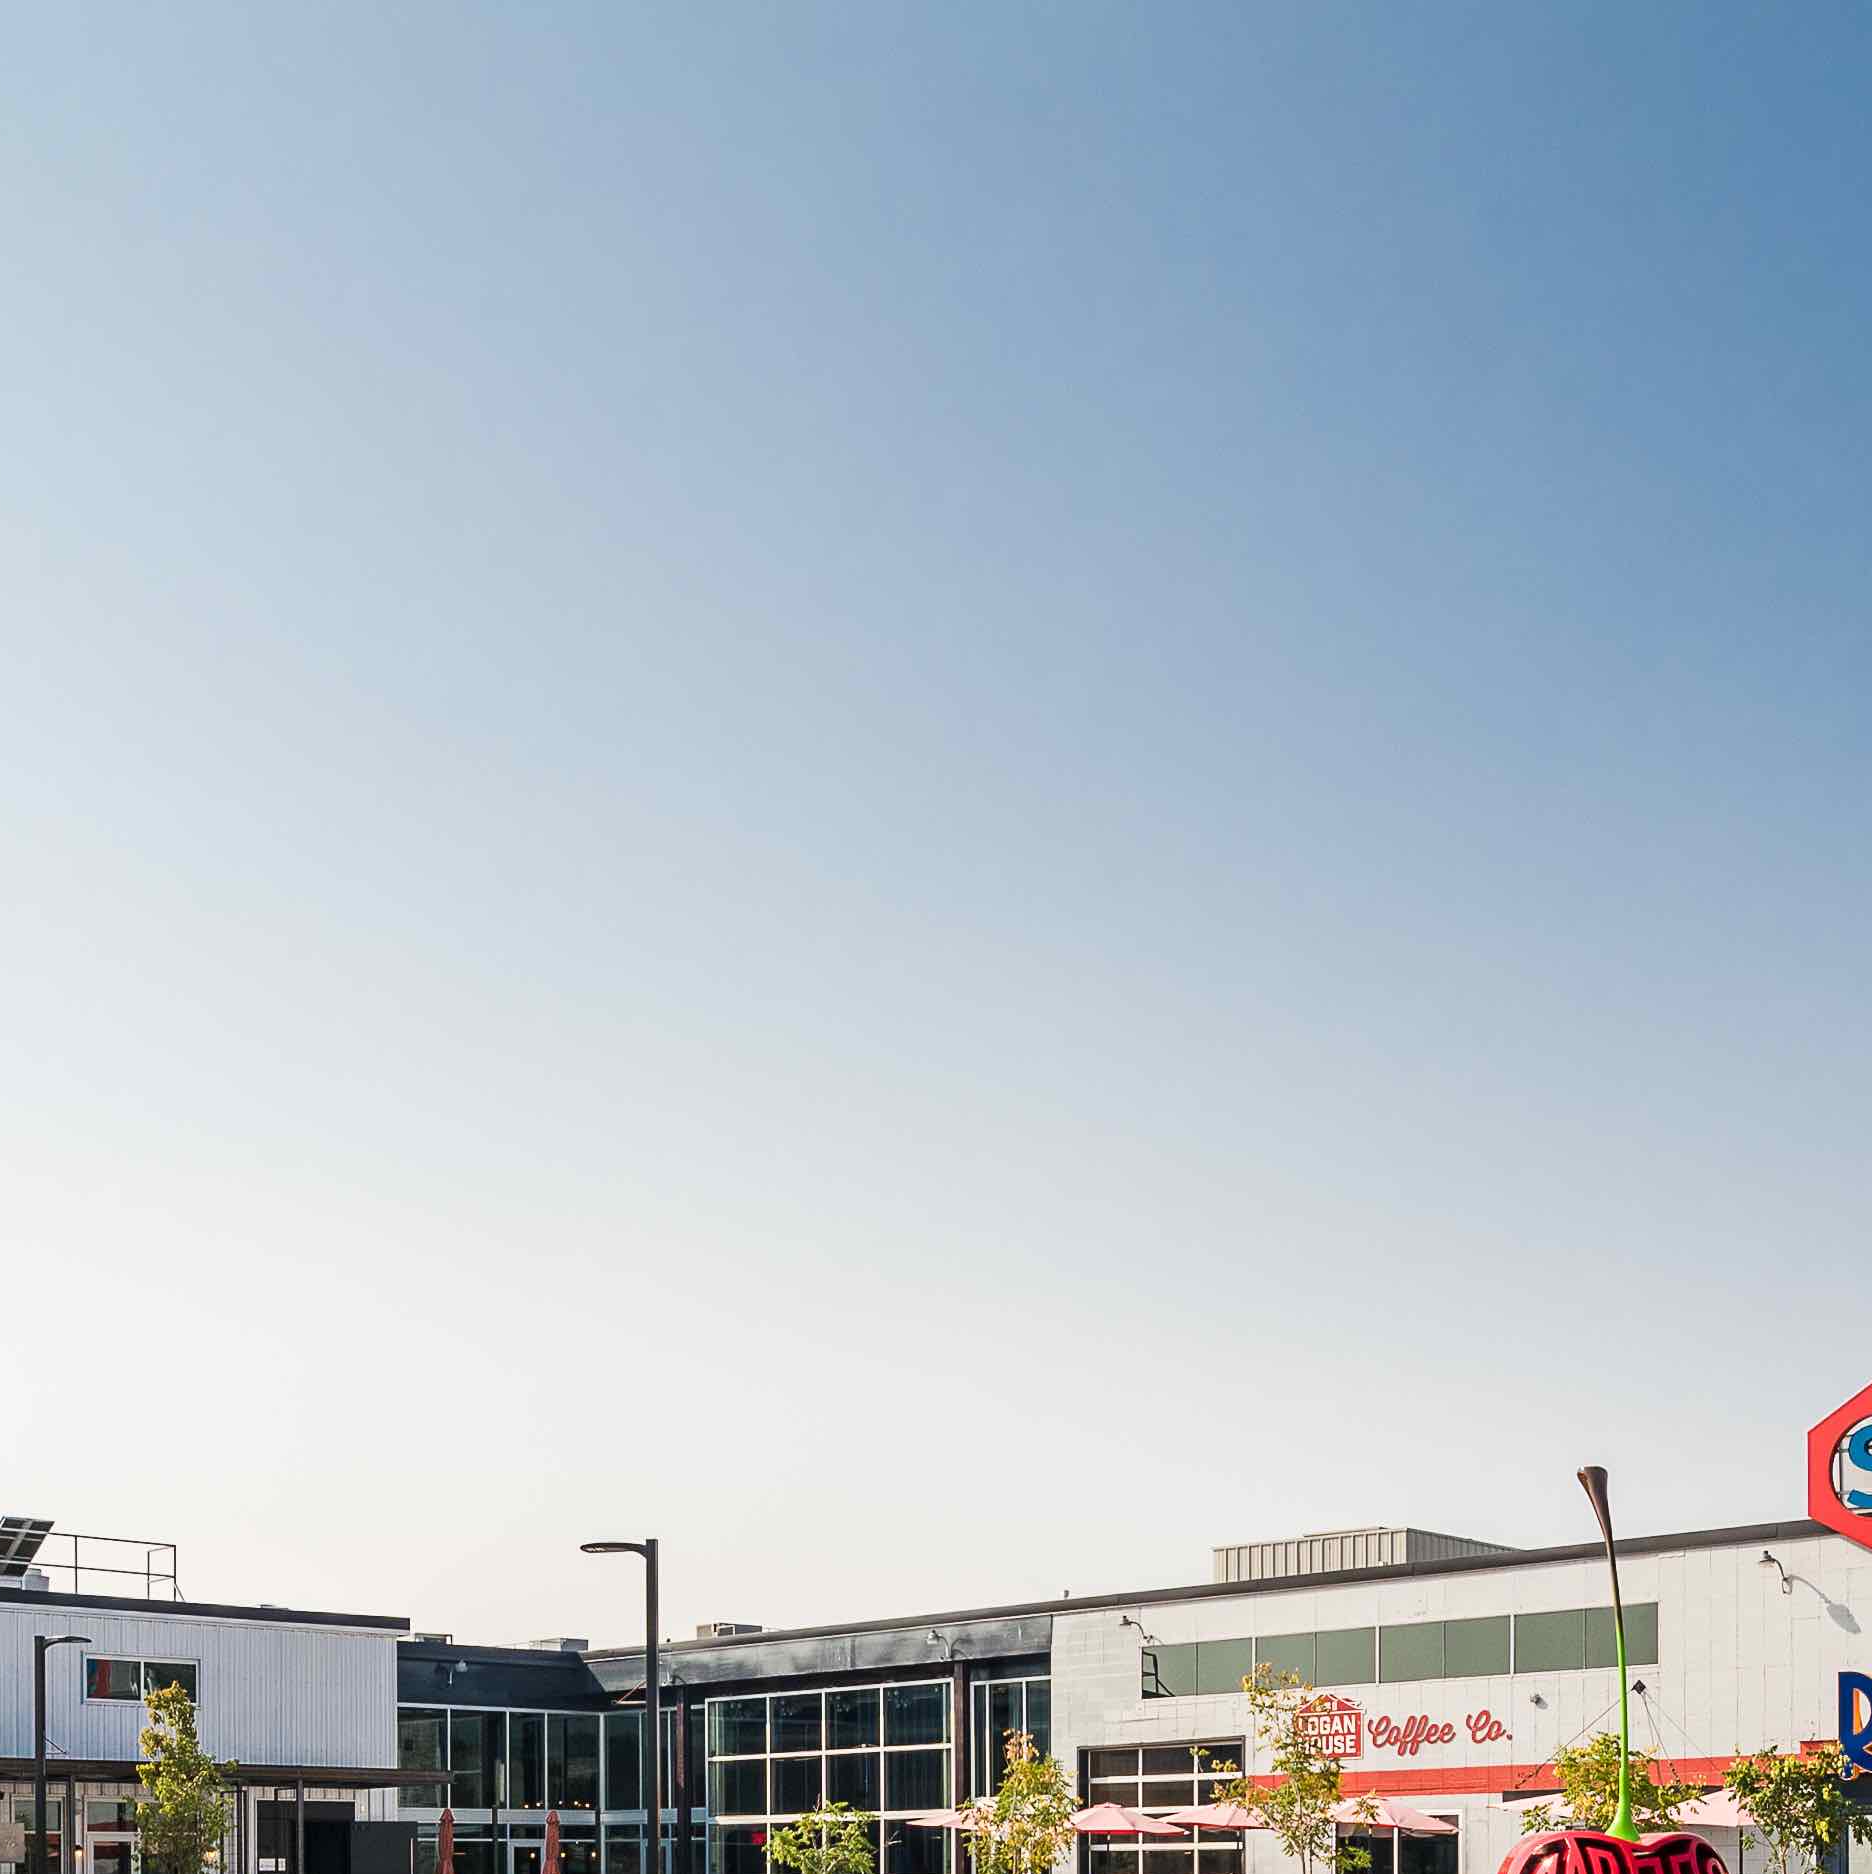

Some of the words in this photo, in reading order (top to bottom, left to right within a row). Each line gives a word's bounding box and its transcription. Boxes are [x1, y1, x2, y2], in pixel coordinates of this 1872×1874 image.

[1298, 1714, 1356, 1735] LOGAN
[1367, 1714, 1457, 1757] Coffee
[1466, 1709, 1513, 1744] Co.
